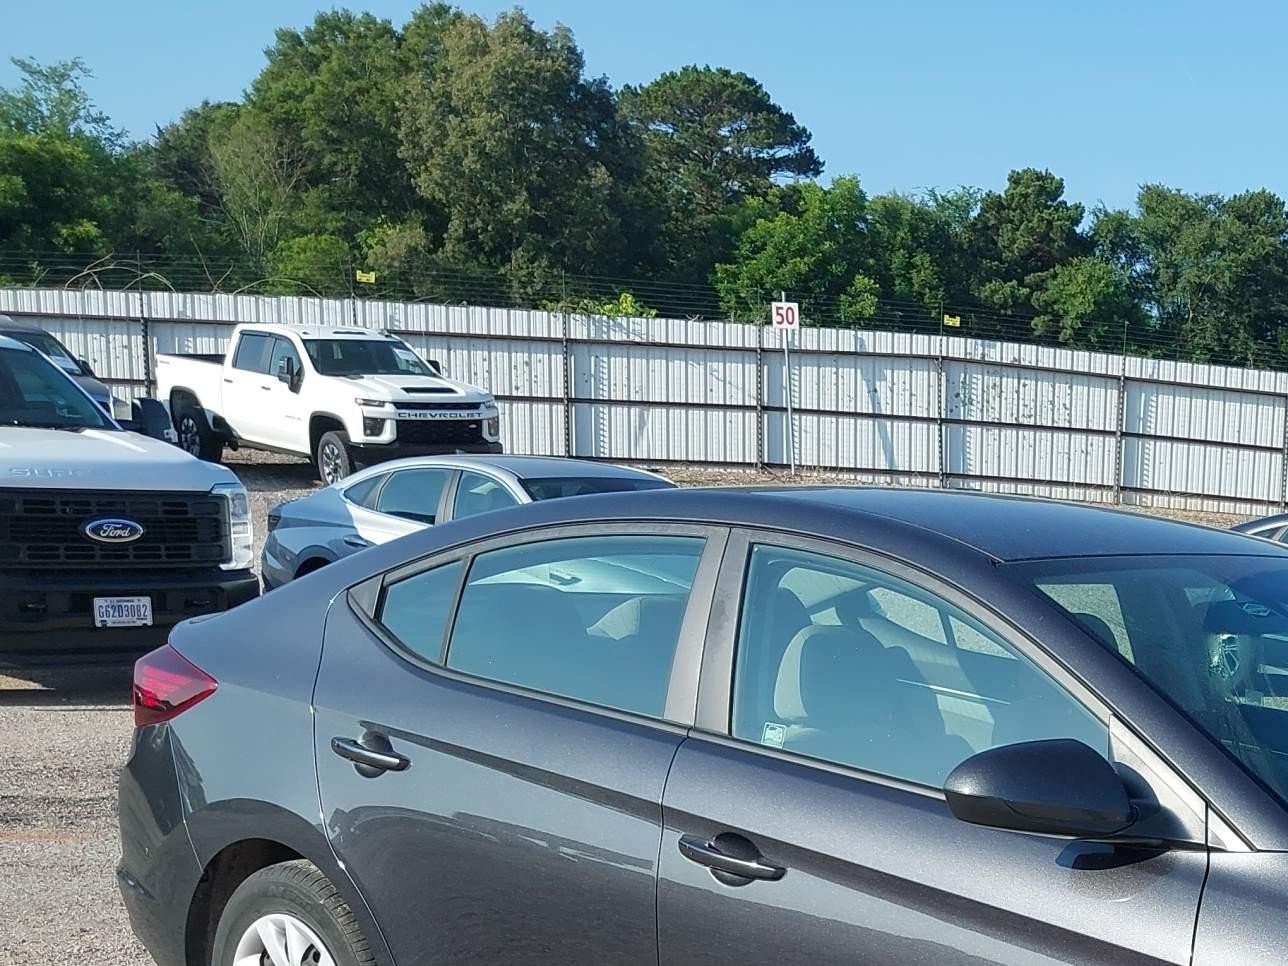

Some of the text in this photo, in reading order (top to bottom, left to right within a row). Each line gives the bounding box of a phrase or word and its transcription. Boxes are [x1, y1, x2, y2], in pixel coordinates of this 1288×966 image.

[776, 306, 795, 325] 50
[397, 411, 483, 419] CHEVROLET
[100, 523, 131, 537] Ford
